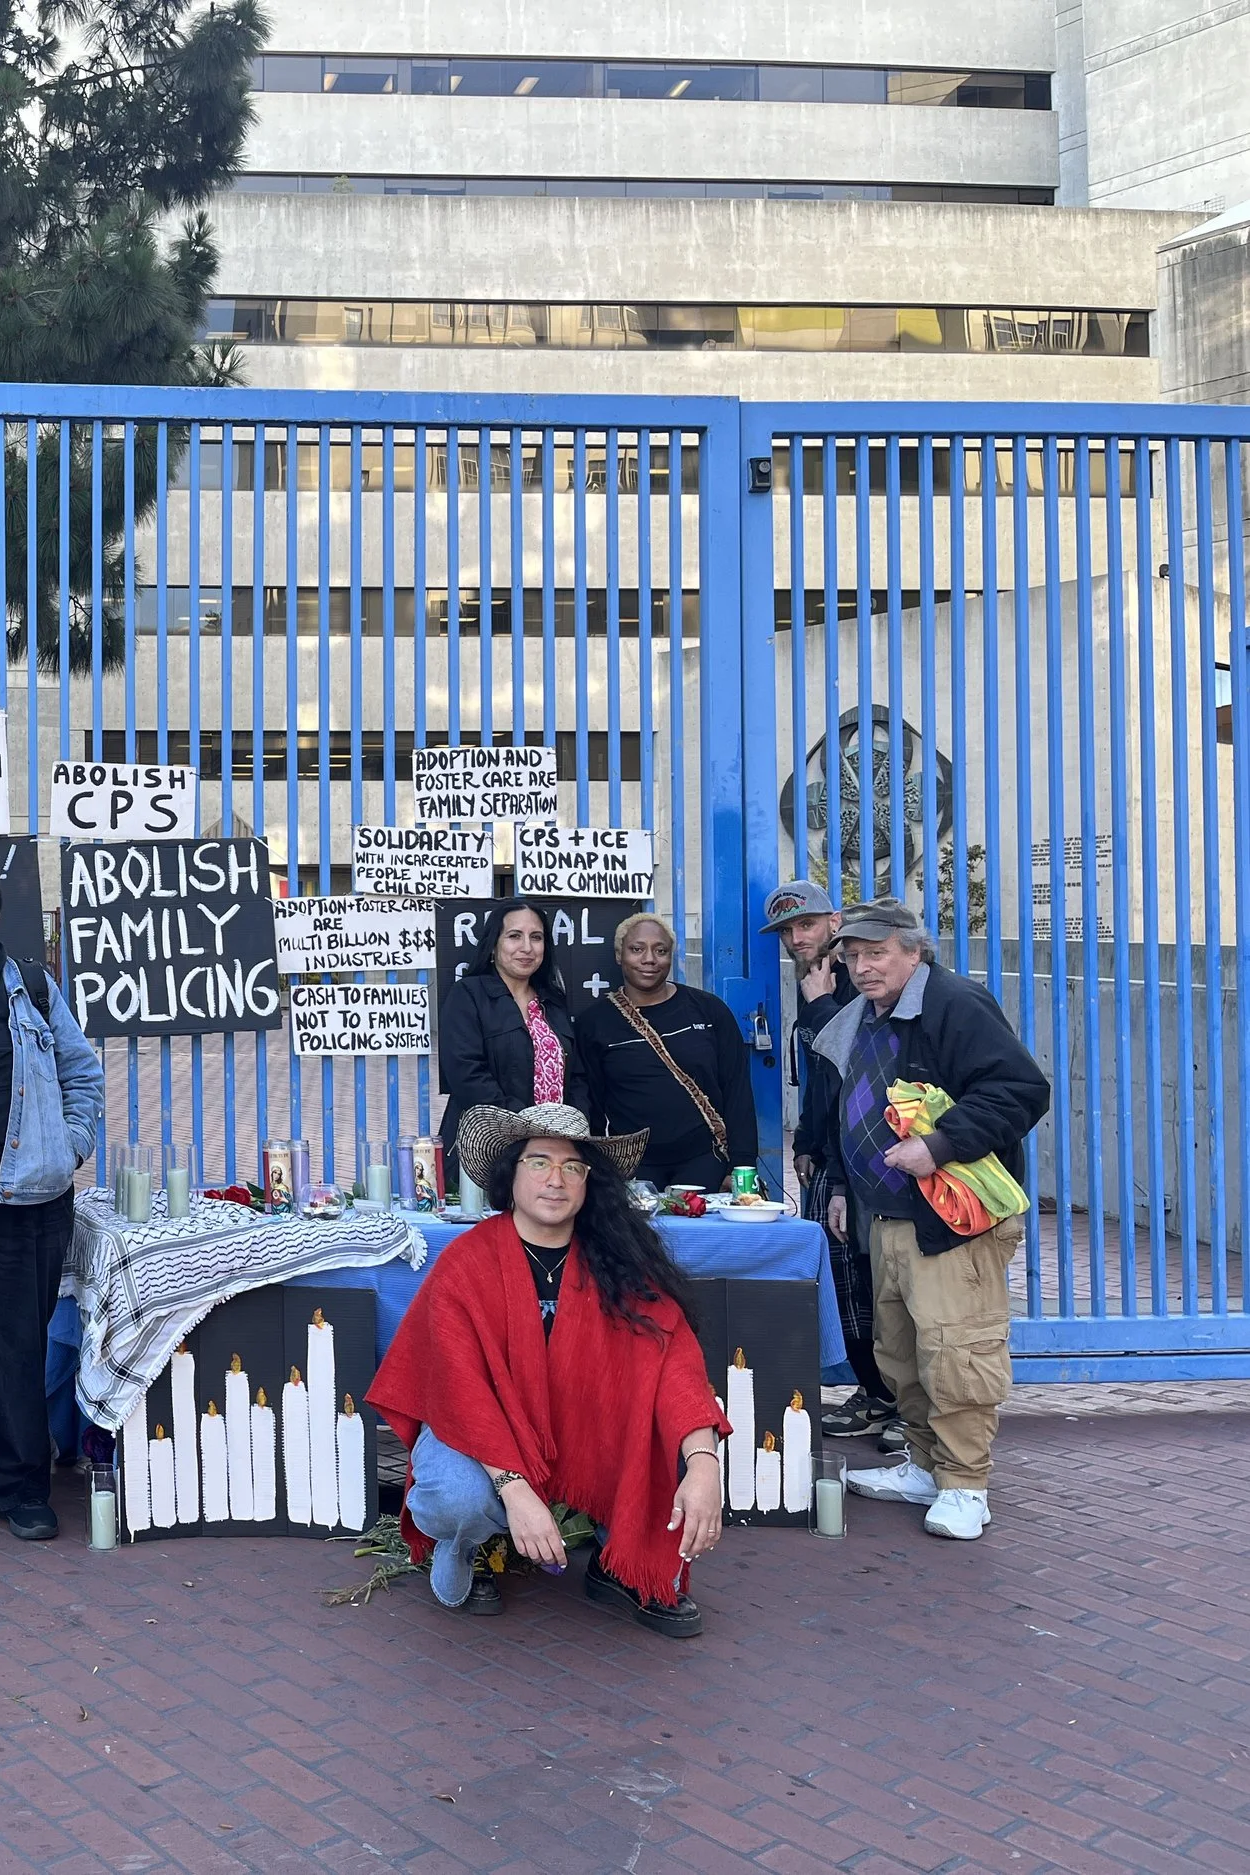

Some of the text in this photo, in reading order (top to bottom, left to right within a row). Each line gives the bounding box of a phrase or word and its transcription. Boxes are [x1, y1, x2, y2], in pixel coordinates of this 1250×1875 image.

[415, 749, 542, 771] ADOPTION AND
[53, 764, 186, 789] ABOLISH
[415, 771, 558, 791] FOSTER CARE ARE
[67, 790, 178, 833] CPS
[416, 791, 558, 818] FAMILY SEPARATION
[358, 828, 486, 852] SOLIDARITY
[519, 828, 629, 849] CPS + ICE
[355, 852, 489, 869] WITH INCARCERATED
[521, 851, 627, 871] KIDNAP IN
[69, 842, 259, 907] ABOLISH
[357, 866, 459, 883] PEOPLE WITH
[521, 872, 654, 895] OUR COMMUNITY
[373, 881, 470, 895] CHILDREN
[402, 899, 433, 912] CARE
[70, 903, 241, 964] FAMILY
[313, 918, 343, 931] ARE
[278, 934, 322, 952] MULTI
[327, 932, 389, 949] BILLION
[305, 952, 413, 971] INDUSTRIES
[73, 958, 279, 1033] POLICING
[292, 987, 428, 1008] CASH TO FAMILIES
[296, 1010, 426, 1031] NOT TO FAMILY
[300, 1032, 430, 1051] POLICING SYSTEMS
